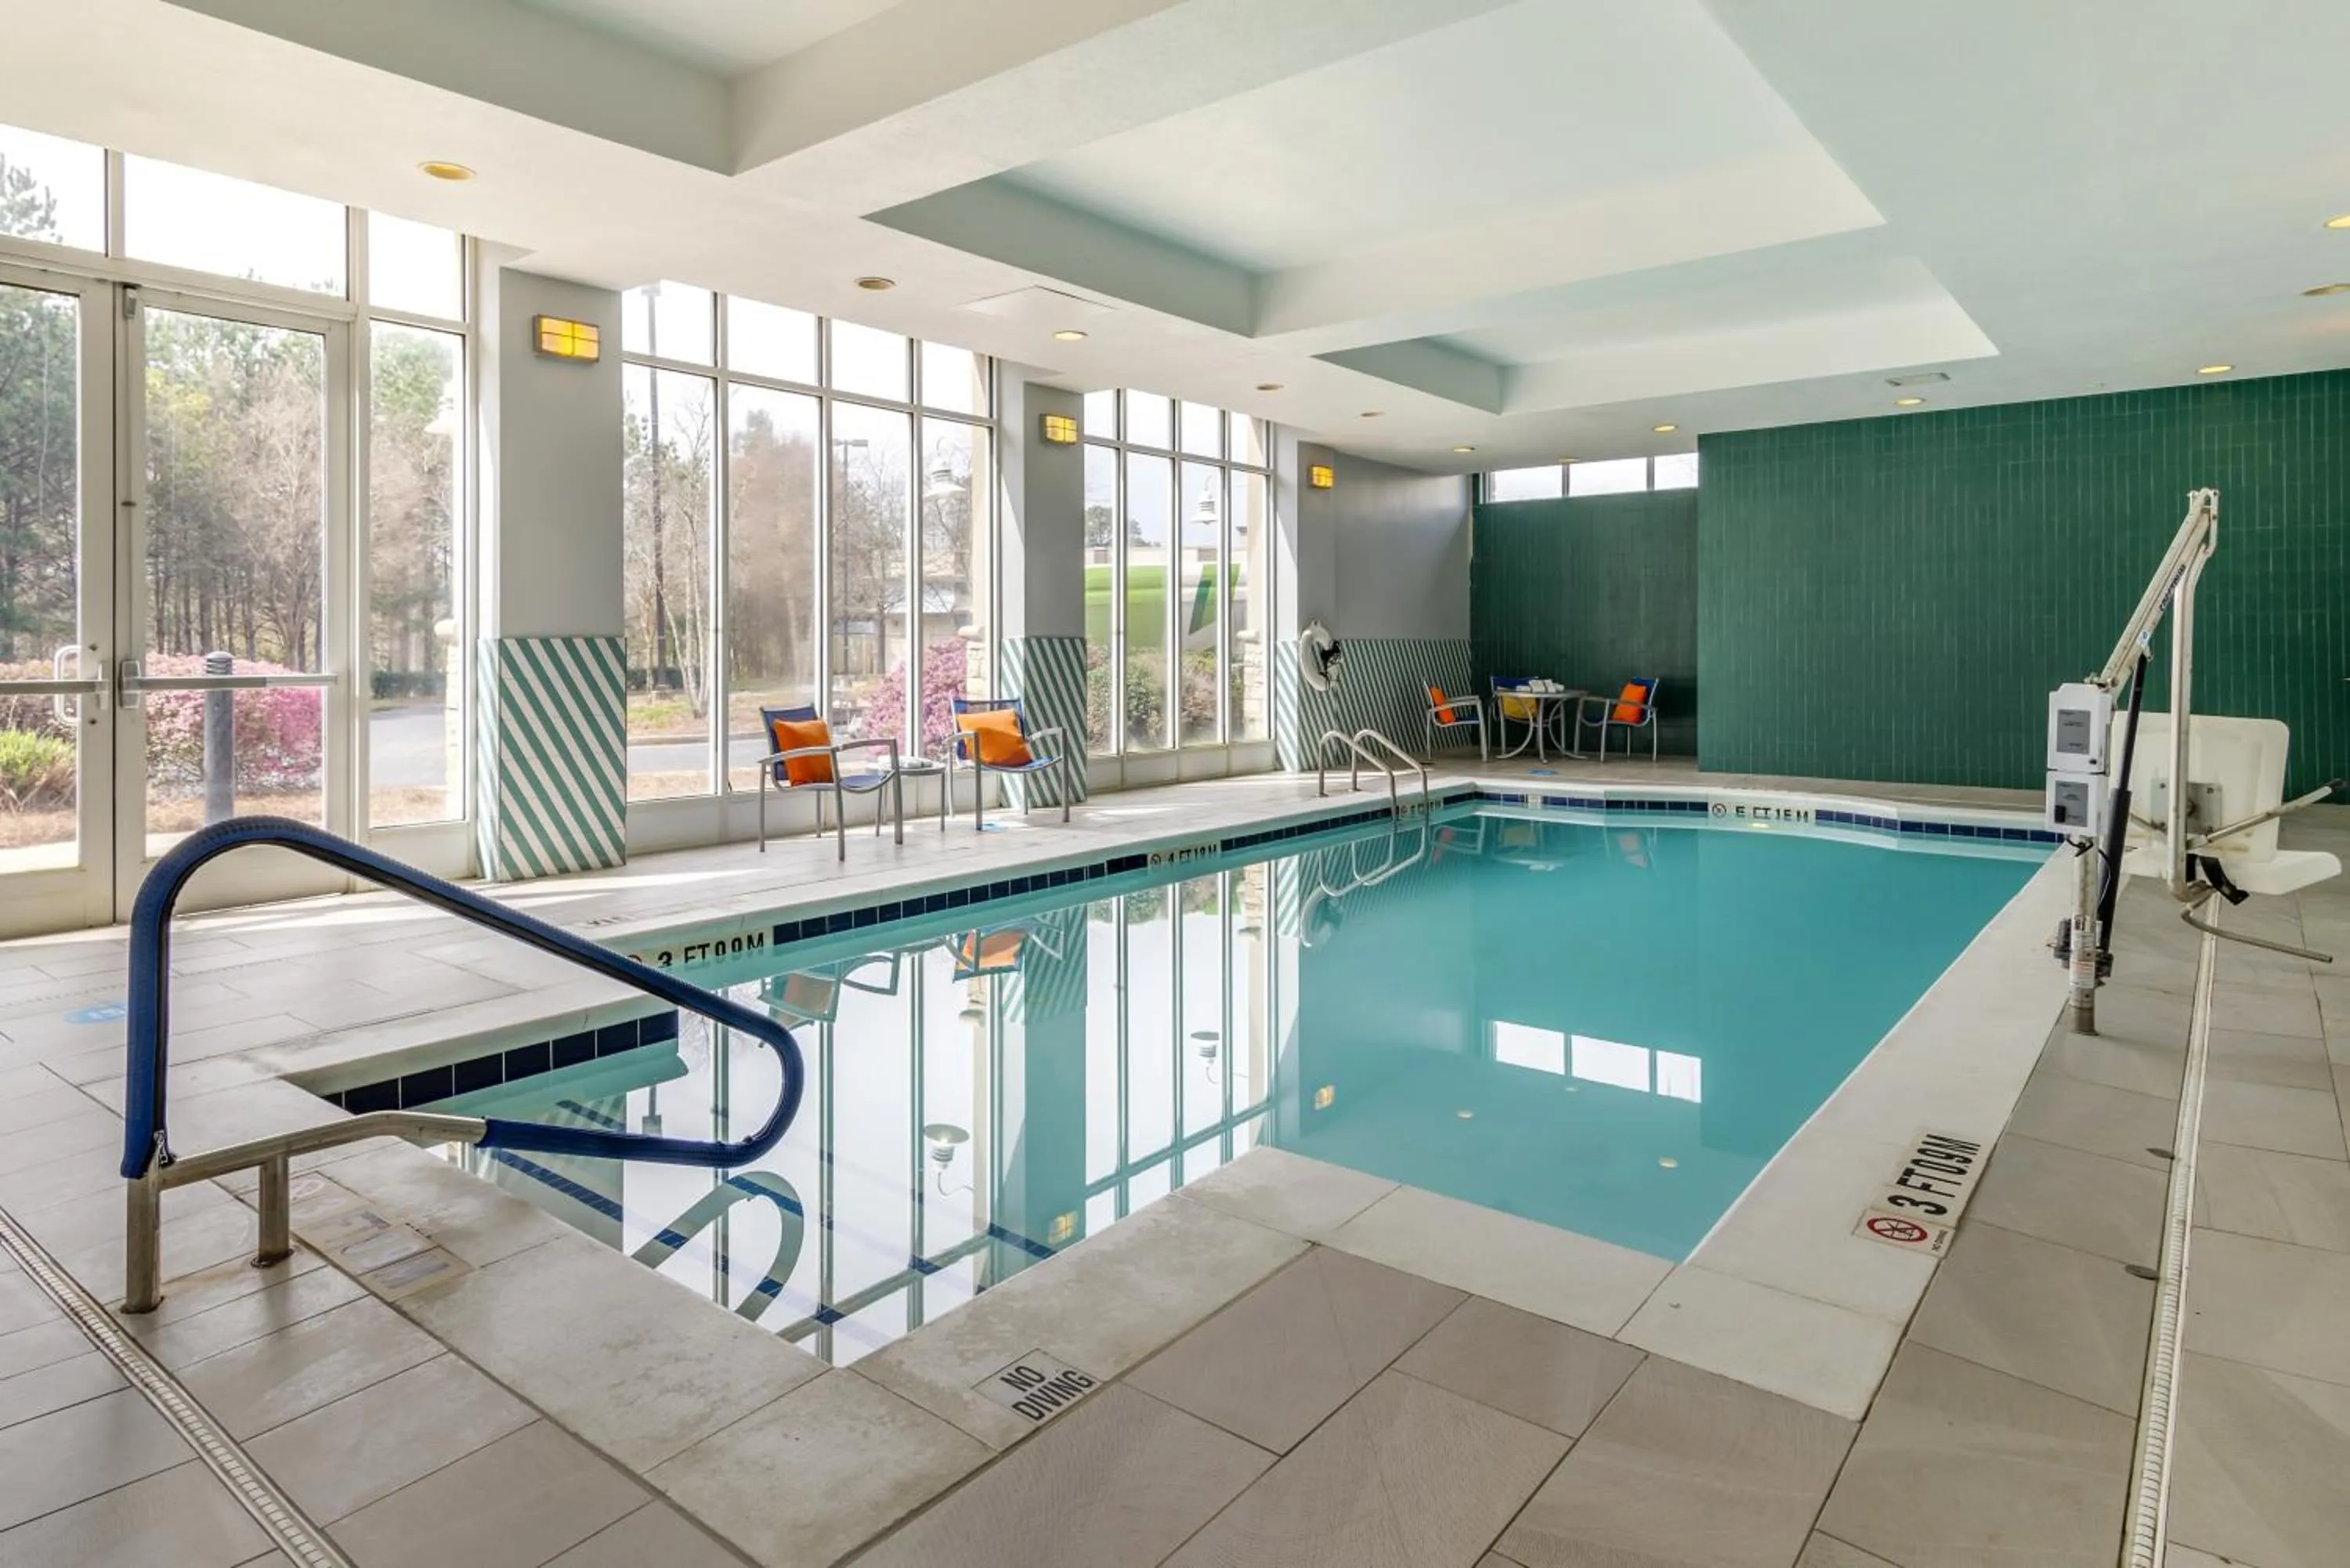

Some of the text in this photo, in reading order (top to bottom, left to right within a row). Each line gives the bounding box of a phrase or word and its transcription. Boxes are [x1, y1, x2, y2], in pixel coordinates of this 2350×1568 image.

[1887, 1194, 1948, 1216] 3
[999, 1365, 1047, 1393] NO
[1011, 1370, 1097, 1422] DIVING
